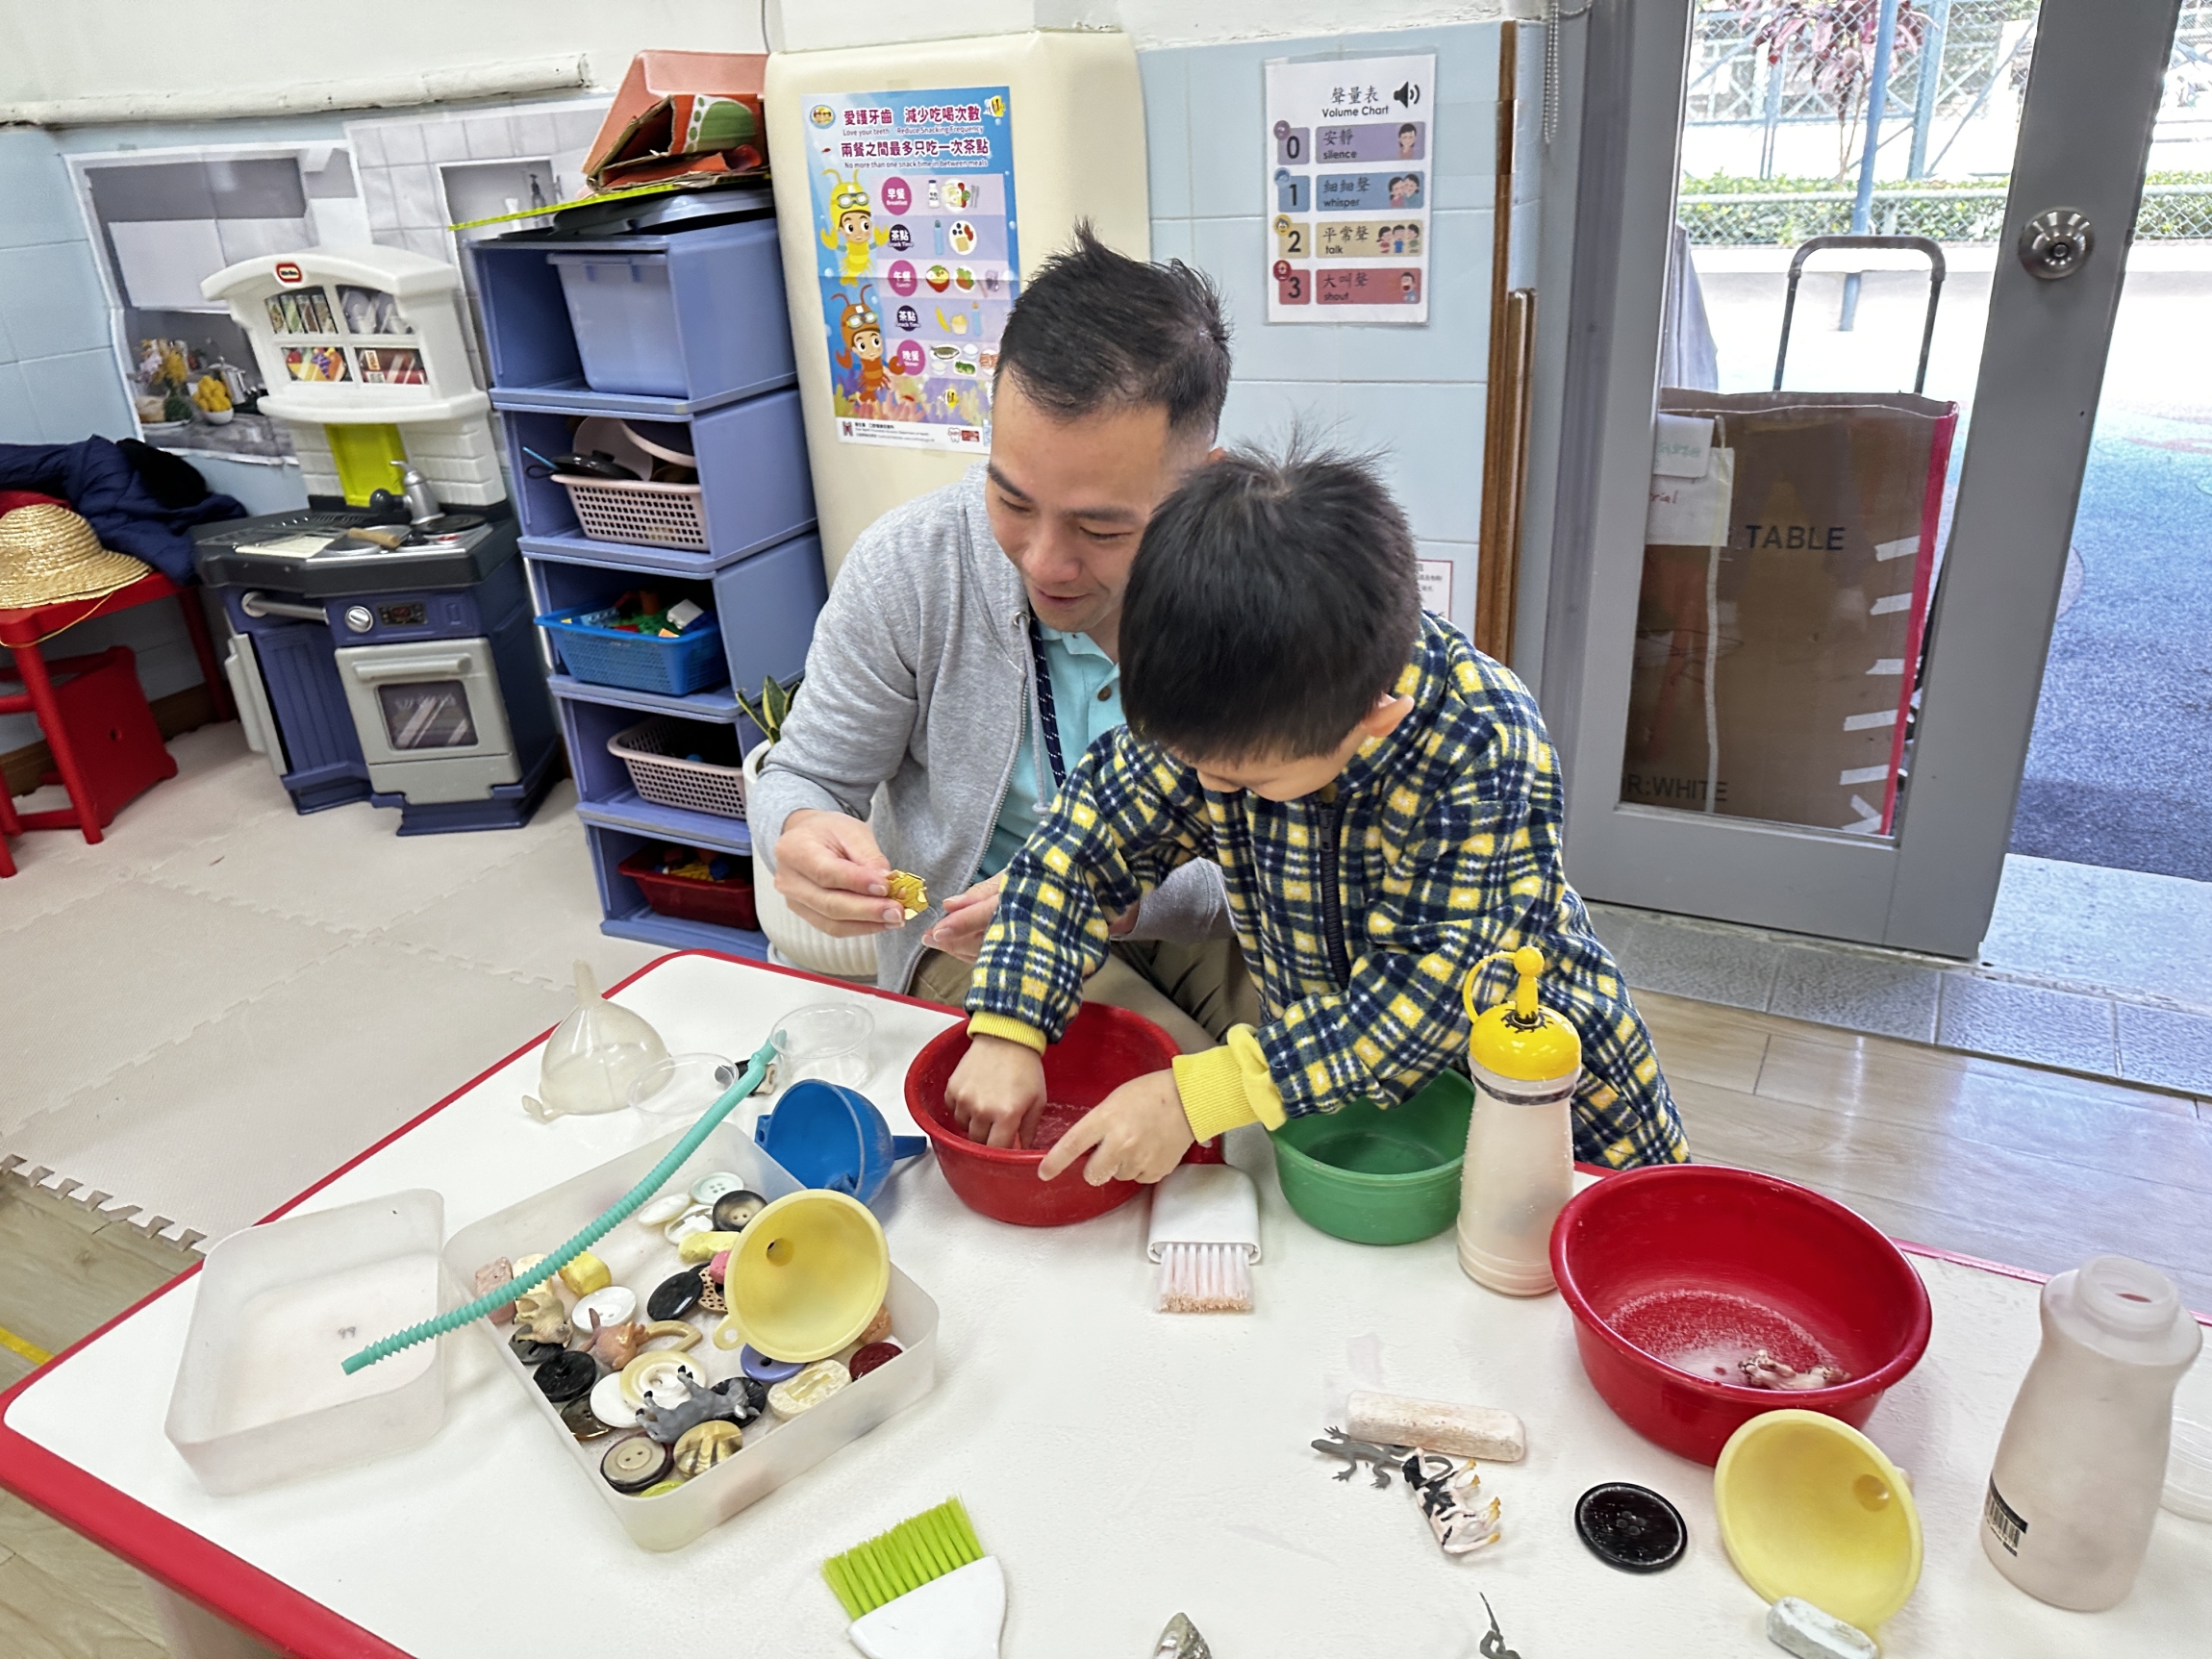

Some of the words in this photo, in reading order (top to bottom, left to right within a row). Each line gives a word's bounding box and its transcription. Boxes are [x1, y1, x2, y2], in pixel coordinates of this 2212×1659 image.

[1330, 85, 1379, 105] 聲量表
[843, 109, 892, 126] 愛護牙齒
[905, 106, 980, 123] 減少吃喝次數
[1321, 108, 1359, 117] Volume
[1362, 105, 1389, 115] Chart
[920, 126, 949, 135] Snacking
[950, 125, 984, 135] Frequency
[1323, 128, 1354, 146] 安靜
[841, 138, 989, 157] 兩餐之間最多只吃一次茶點
[1287, 136, 1300, 159] 0
[1323, 149, 1357, 160] silence
[1323, 176, 1370, 193] 細細聲
[887, 188, 905, 199] 早餐
[1289, 184, 1297, 206] 1
[1323, 197, 1360, 208] whisper
[891, 230, 909, 241] 茶點
[1288, 230, 1301, 253] 2
[1322, 226, 1370, 242] 平常聲
[1325, 245, 1343, 254] talk
[1288, 276, 1301, 299] 3
[1323, 272, 1370, 289] 大叫聲
[1323, 291, 1349, 301] shout
[898, 311, 917, 321] 茶點
[1746, 525, 1846, 551] TABLE
[1621, 773, 1728, 802] R:WHITE
